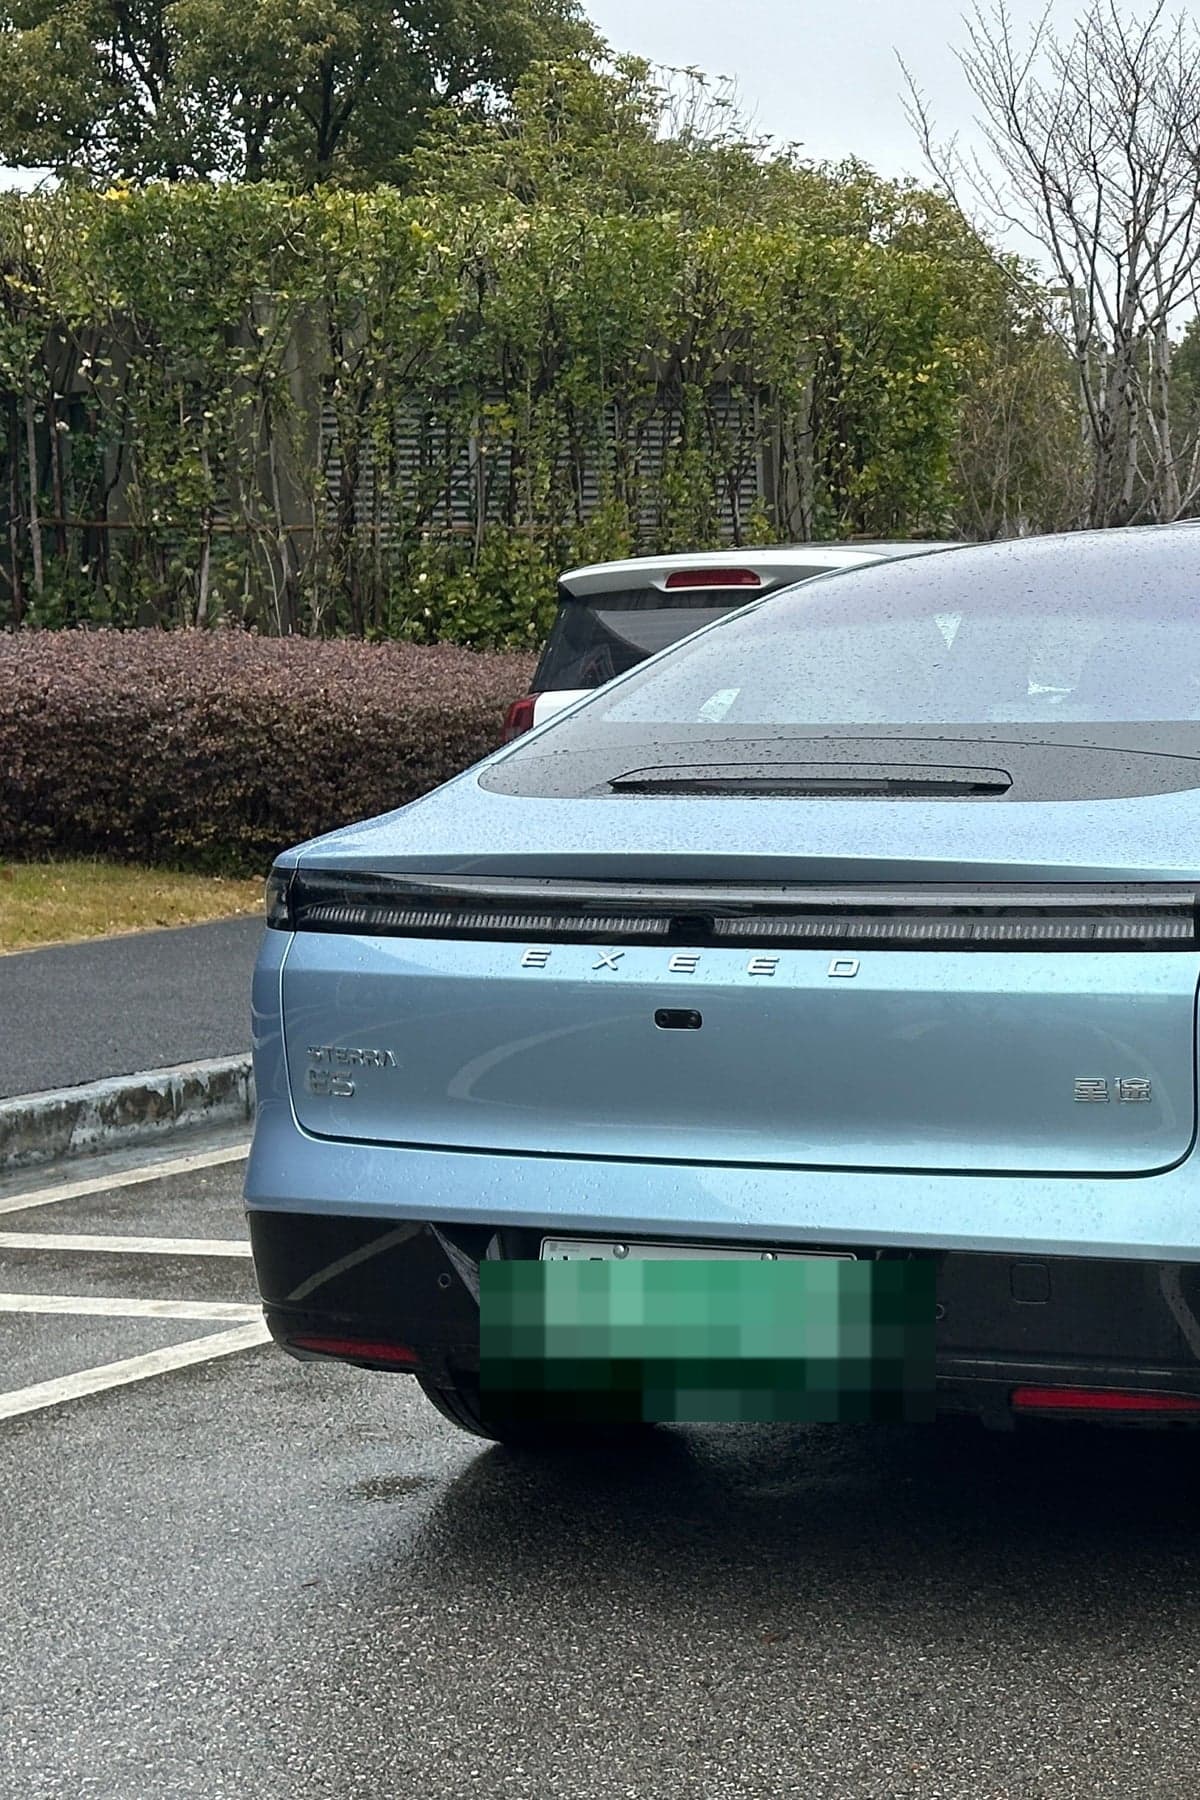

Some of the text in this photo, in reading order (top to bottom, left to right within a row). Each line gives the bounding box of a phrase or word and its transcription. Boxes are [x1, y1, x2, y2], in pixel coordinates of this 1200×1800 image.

[520, 948, 861, 978] EXEED
[306, 1044, 397, 1068] STERRA
[1073, 1076, 1152, 1104] 星途
